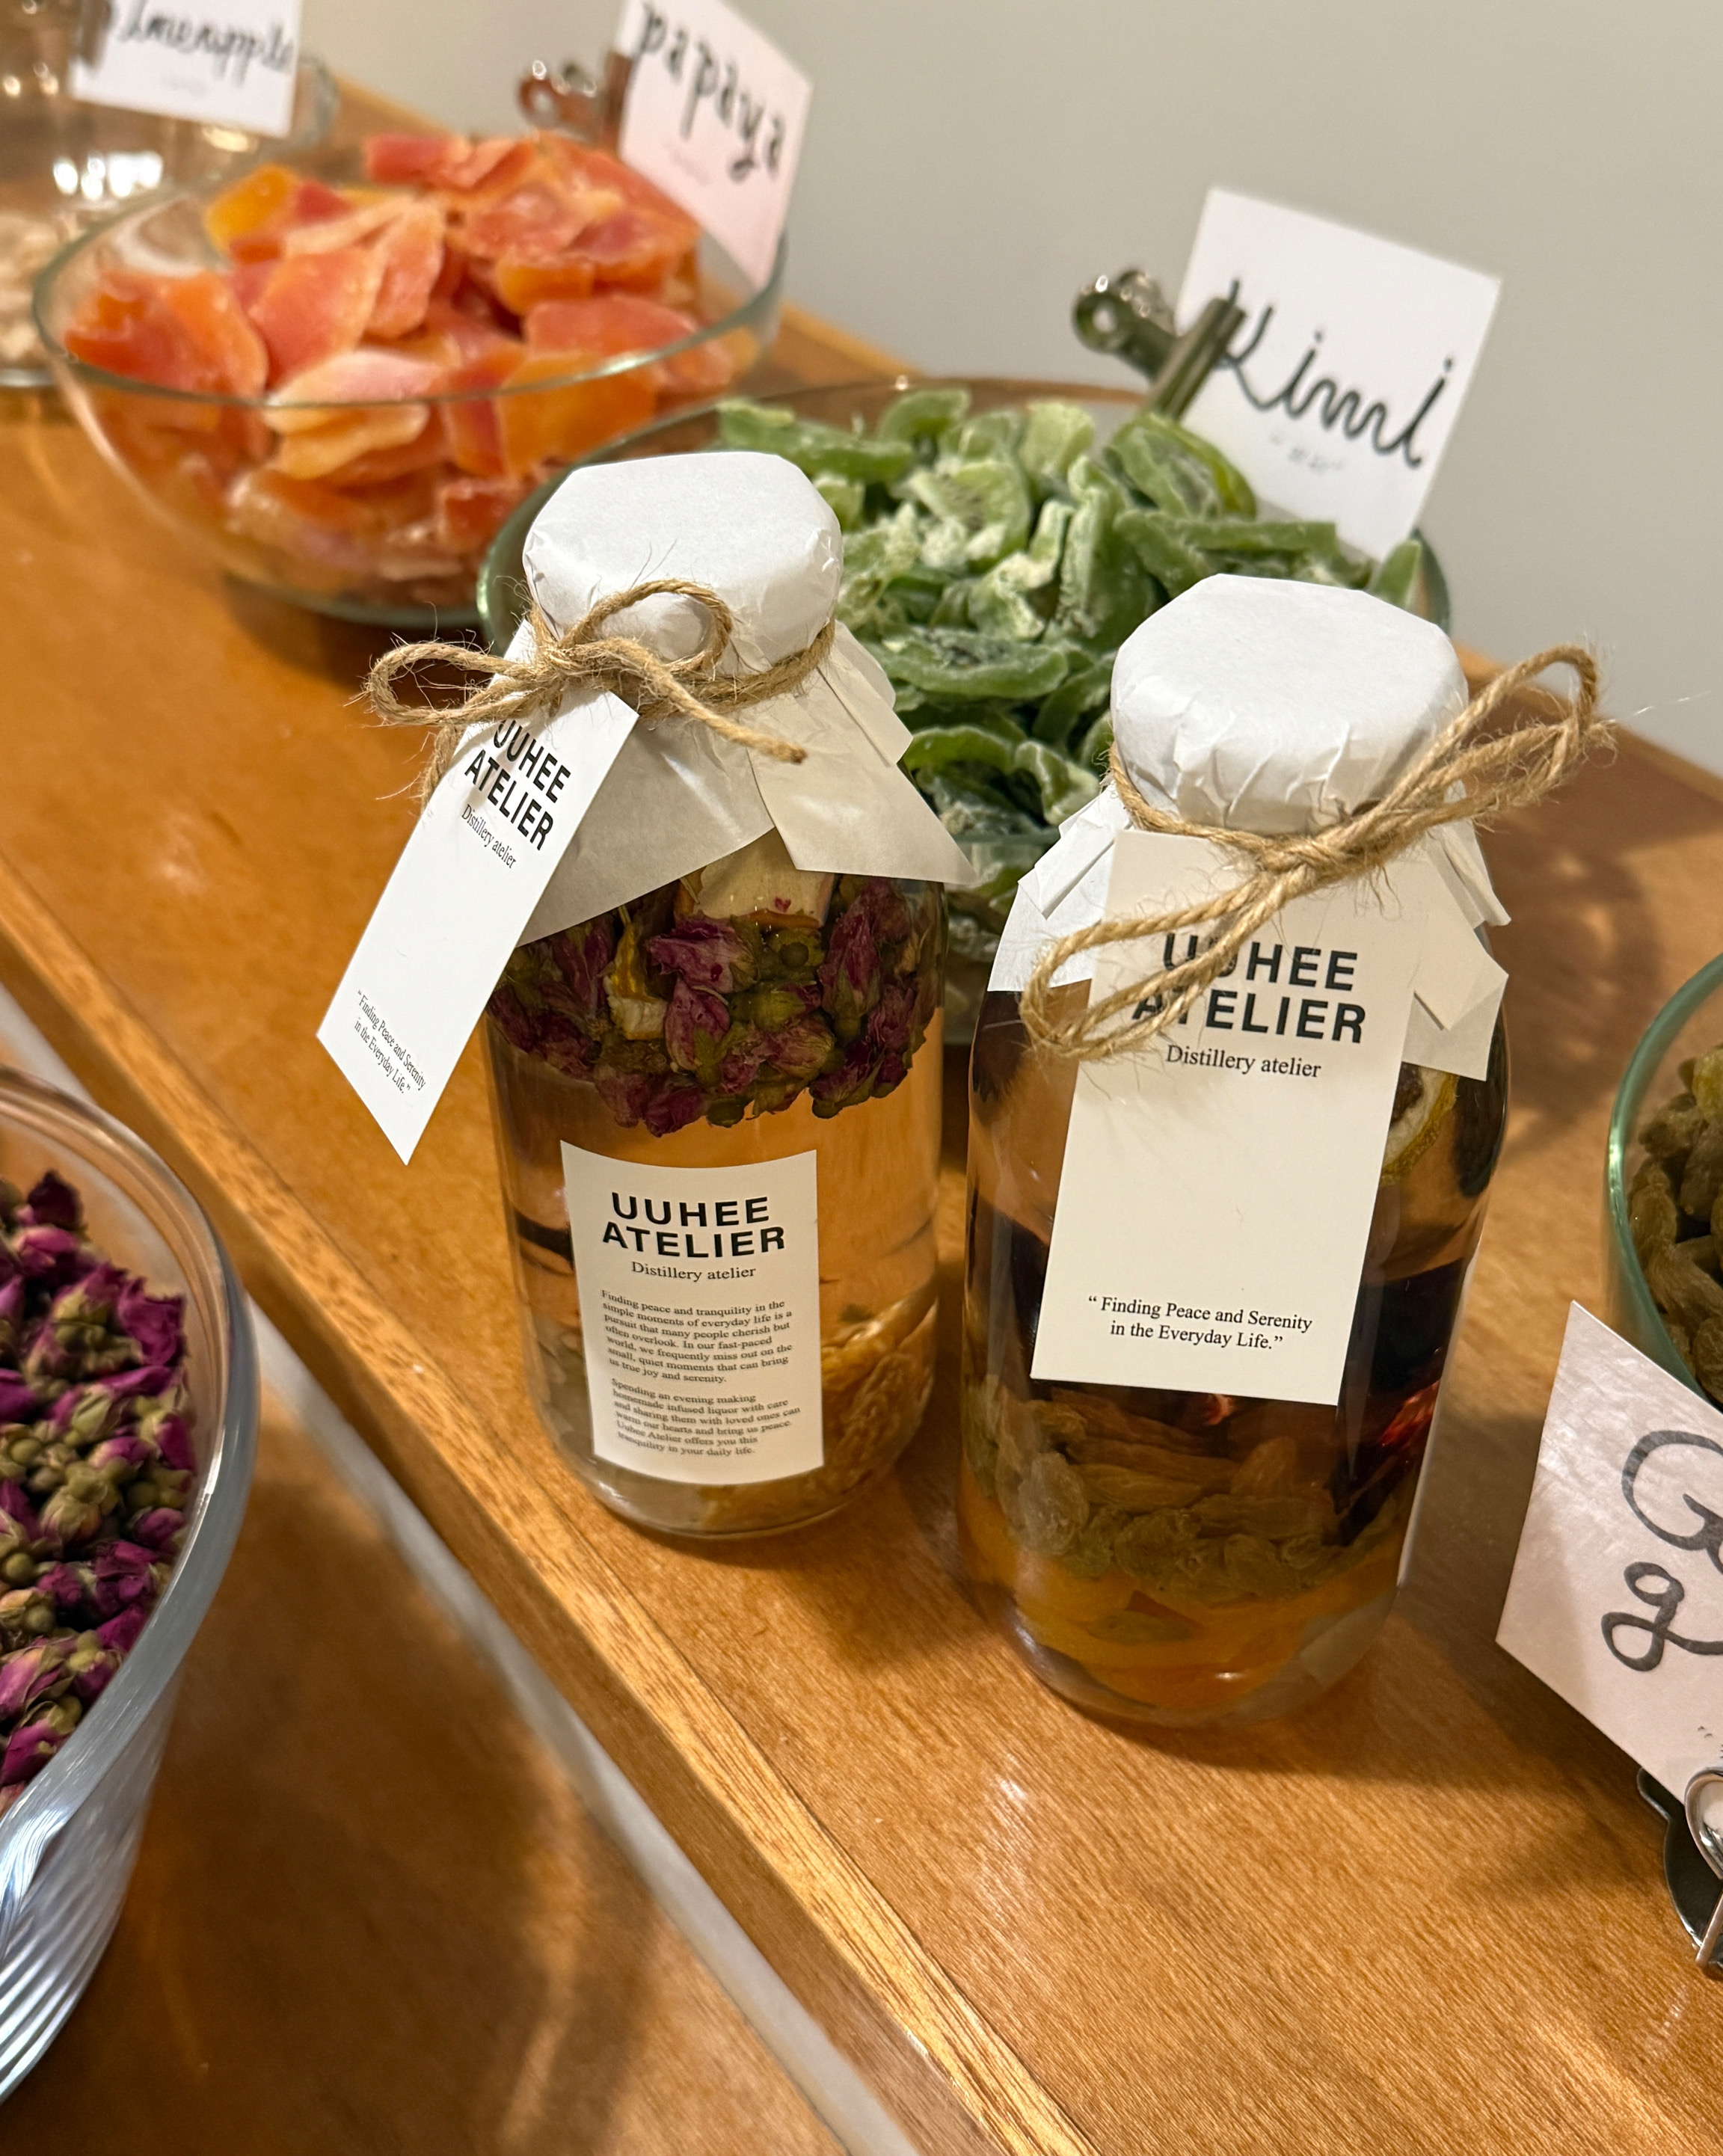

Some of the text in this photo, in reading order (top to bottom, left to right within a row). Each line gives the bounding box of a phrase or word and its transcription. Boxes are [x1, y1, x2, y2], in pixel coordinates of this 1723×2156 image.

[634, 2, 784, 184] papaya
[494, 719, 571, 804] UUHEE
[464, 749, 554, 851] ATELIER
[461, 804, 516, 868] Distillery atelier
[354, 1017, 361, 1033] in
[360, 1027, 370, 1043] the
[369, 1036, 394, 1077] Everyday
[378, 1019, 395, 1047] Peace
[393, 1043, 407, 1060] and
[404, 1054, 426, 1091] Serenity
[1166, 1044, 1321, 1078] Distillery atelier
[612, 1192, 769, 1227] UUHEE
[602, 1221, 784, 1258] ATELIER
[631, 1261, 756, 1282] Distillery atelier
[602, 1290, 639, 1309] Finding
[642, 1303, 671, 1313] peace
[696, 1306, 752, 1317] tranquility
[769, 1301, 784, 1309] the
[603, 1303, 634, 1317] simple
[637, 1313, 684, 1326] moments
[701, 1318, 750, 1327] everyday
[754, 1314, 771, 1323] life
[1166, 1303, 1211, 1321] Peace
[1215, 1309, 1243, 1324] and
[1248, 1310, 1312, 1333] Serenity
[604, 1314, 790, 1339] pursuit that many people cherish but
[606, 1326, 629, 1337] often
[719, 1336, 772, 1349] fast-paced
[1110, 1321, 1125, 1335] in
[1131, 1323, 1153, 1338] the
[1159, 1324, 1232, 1348] Everyday
[606, 1336, 636, 1351] world,
[658, 1348, 710, 1362] frequently
[777, 1345, 792, 1353] the
[608, 1348, 636, 1362] small,
[639, 1357, 663, 1367] quiet
[667, 1362, 714, 1371] moments
[761, 1357, 789, 1367] bring
[609, 1358, 619, 1366] us
[622, 1362, 640, 1372] true
[643, 1366, 659, 1378] joy
[684, 1375, 727, 1383] serenity.
